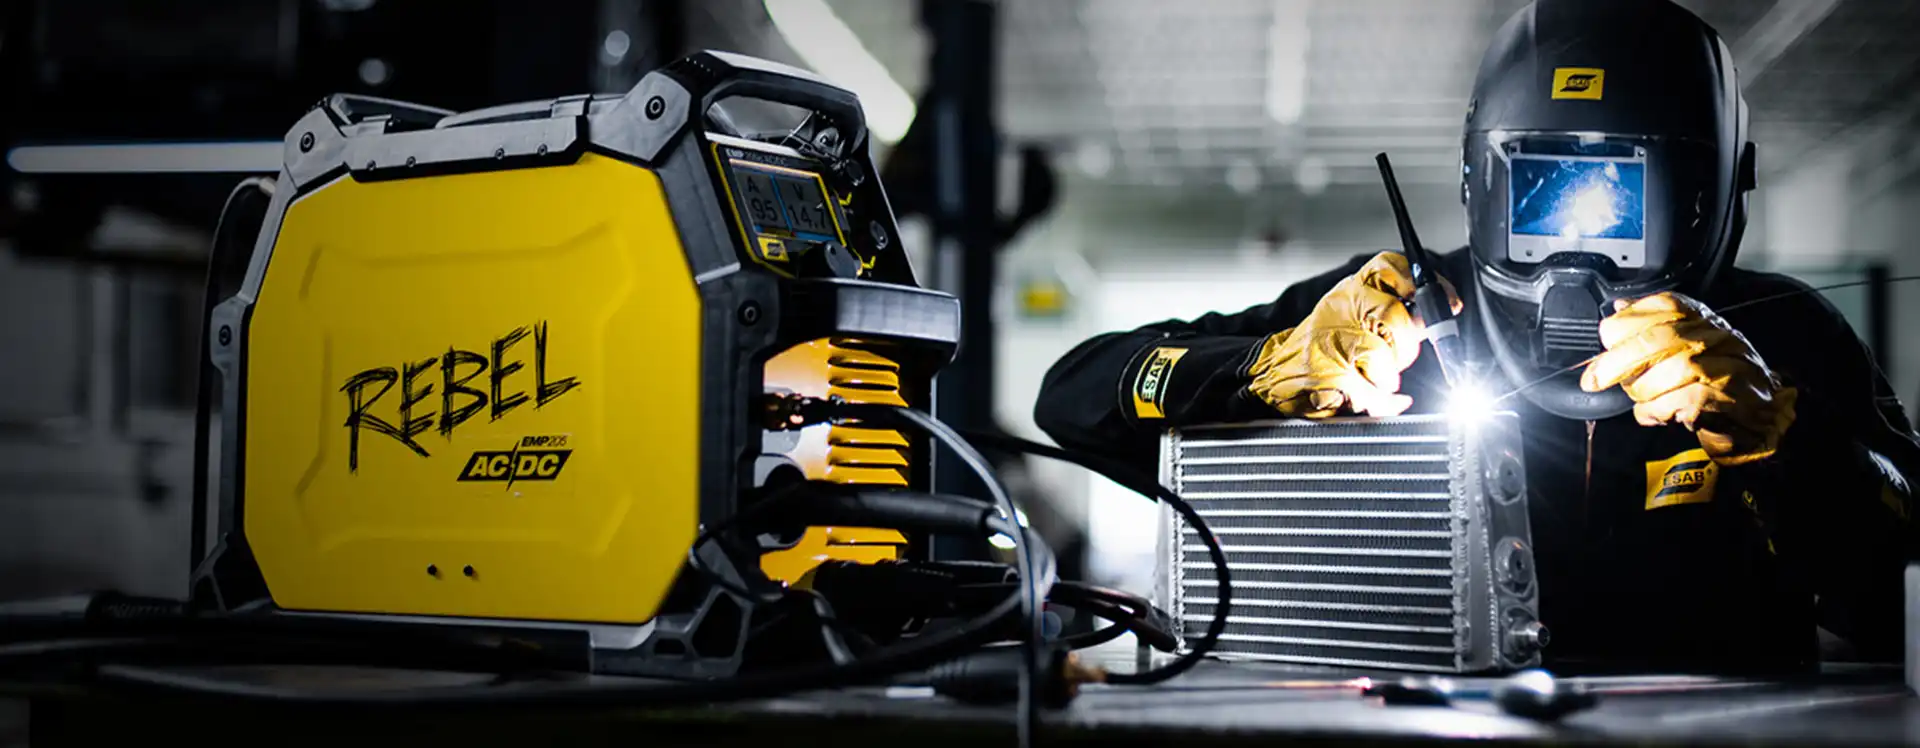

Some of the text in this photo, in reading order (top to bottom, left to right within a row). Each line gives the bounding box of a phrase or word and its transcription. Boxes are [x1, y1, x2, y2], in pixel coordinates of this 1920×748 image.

[747, 175, 761, 193] A
[792, 182, 804, 201] V
[751, 197, 778, 221] 95
[788, 204, 826, 229] 14.7
[1143, 356, 1169, 402] ESAB
[339, 319, 582, 477] REBEL
